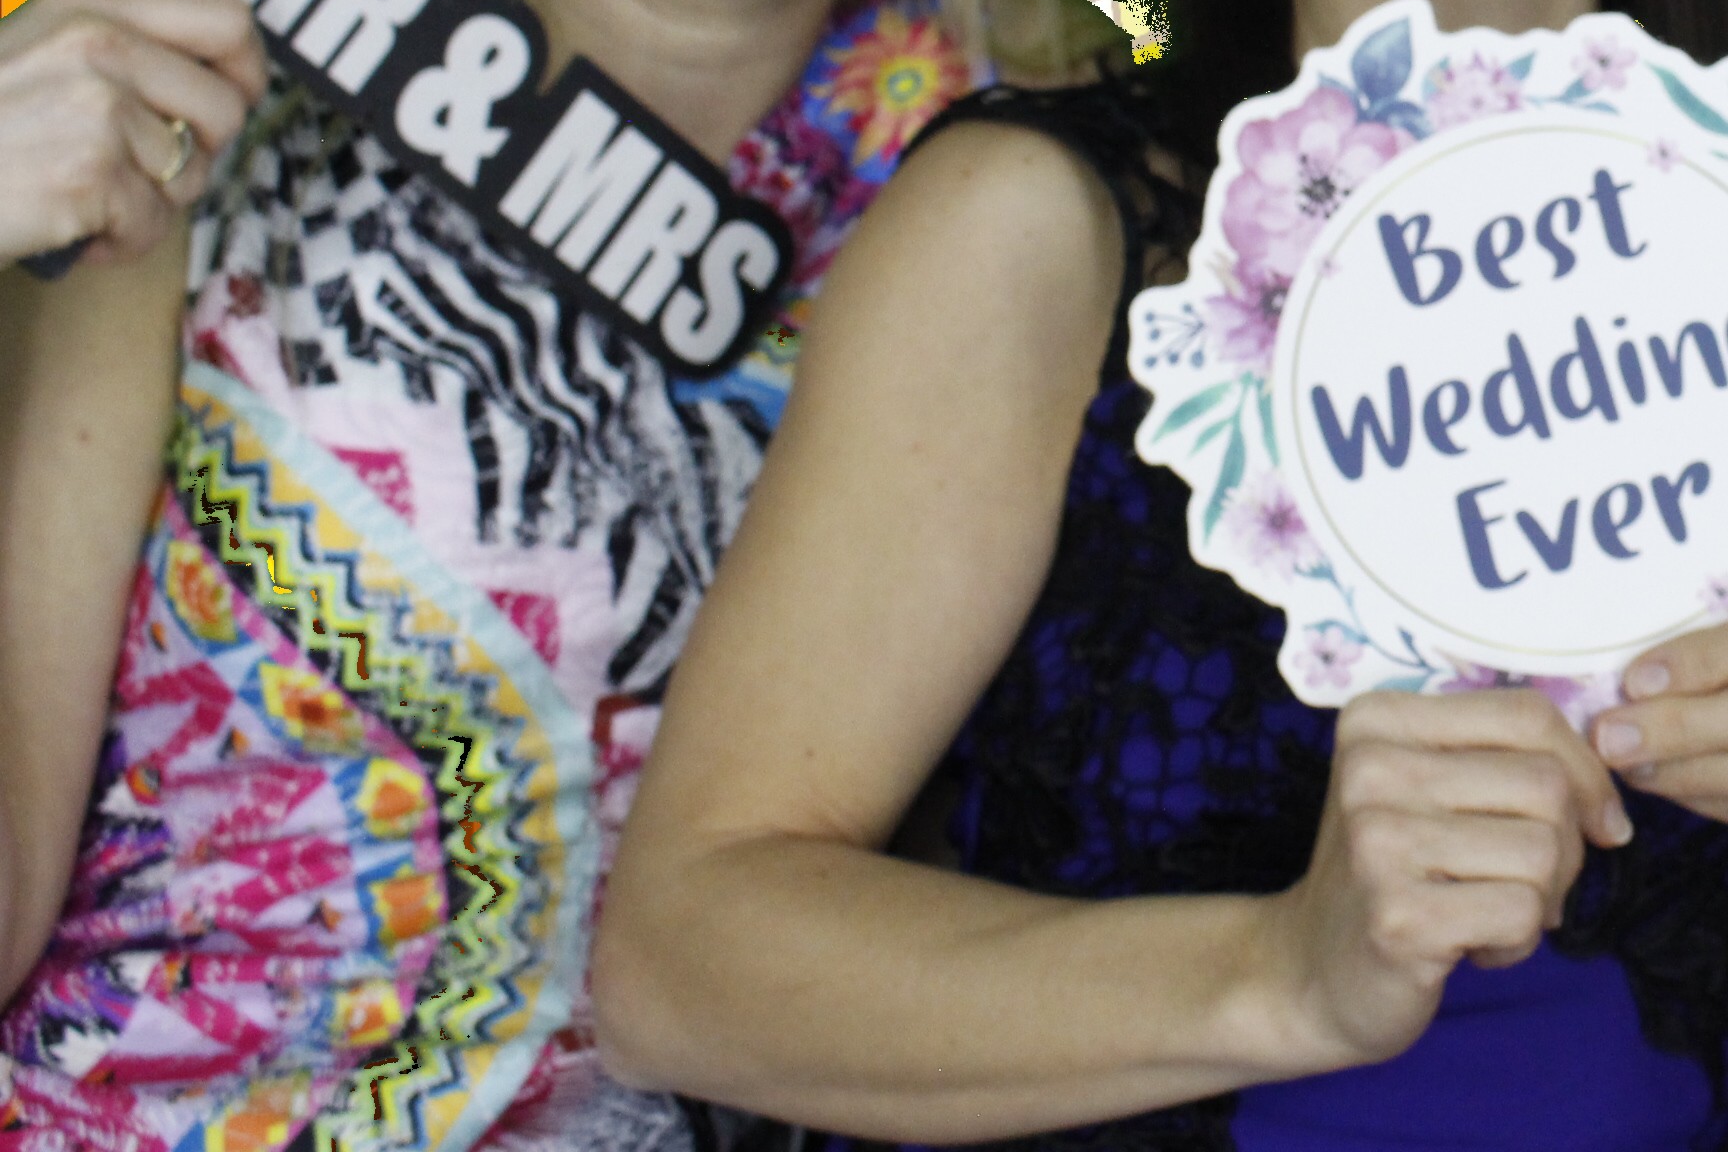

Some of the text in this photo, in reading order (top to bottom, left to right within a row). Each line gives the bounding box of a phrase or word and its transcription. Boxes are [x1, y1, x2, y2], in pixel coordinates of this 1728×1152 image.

[395, 12, 531, 188] &
[498, 88, 780, 366] MRS
[1376, 167, 1648, 307] Best
[1454, 459, 1712, 591] Ever
